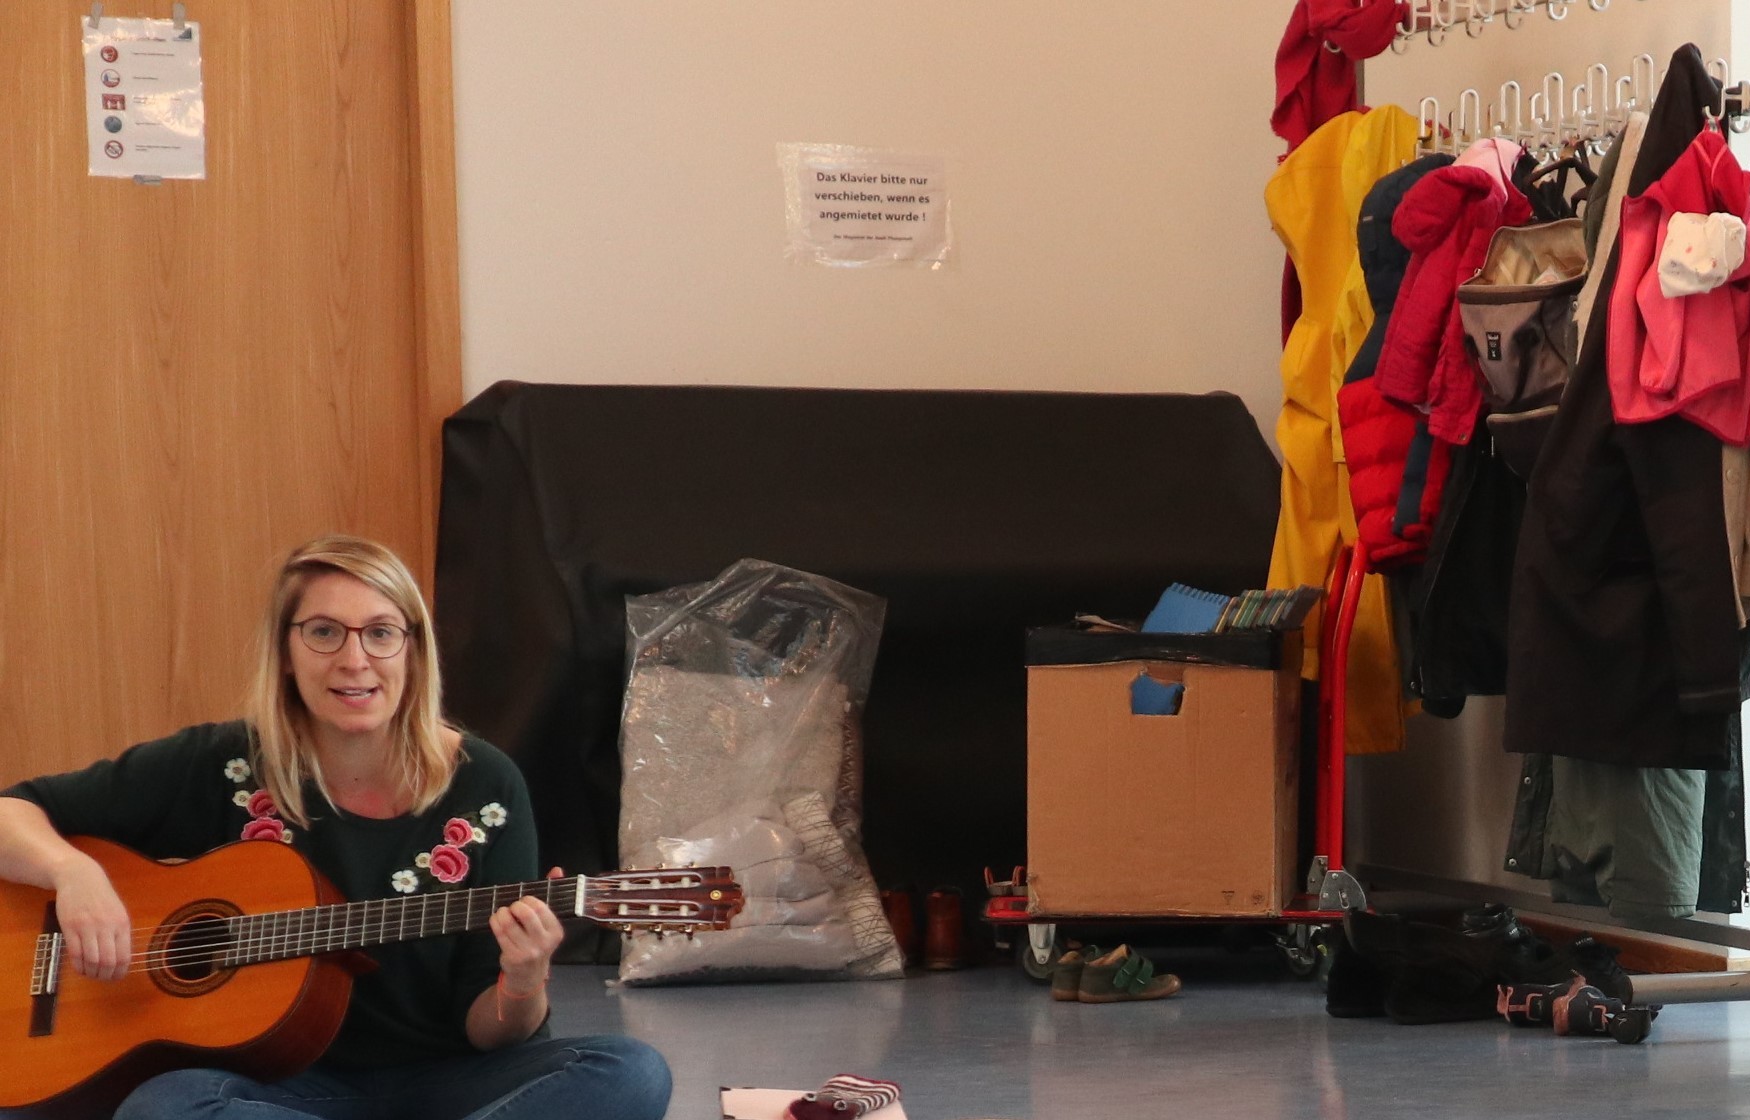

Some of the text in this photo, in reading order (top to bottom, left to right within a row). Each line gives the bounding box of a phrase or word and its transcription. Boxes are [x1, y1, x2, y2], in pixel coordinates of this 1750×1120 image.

[816, 172, 928, 185] Das Klavier bitte nur
[814, 191, 930, 204] verschieben, wenn es
[819, 210, 882, 221] angemietet
[885, 211, 919, 221] wurde
